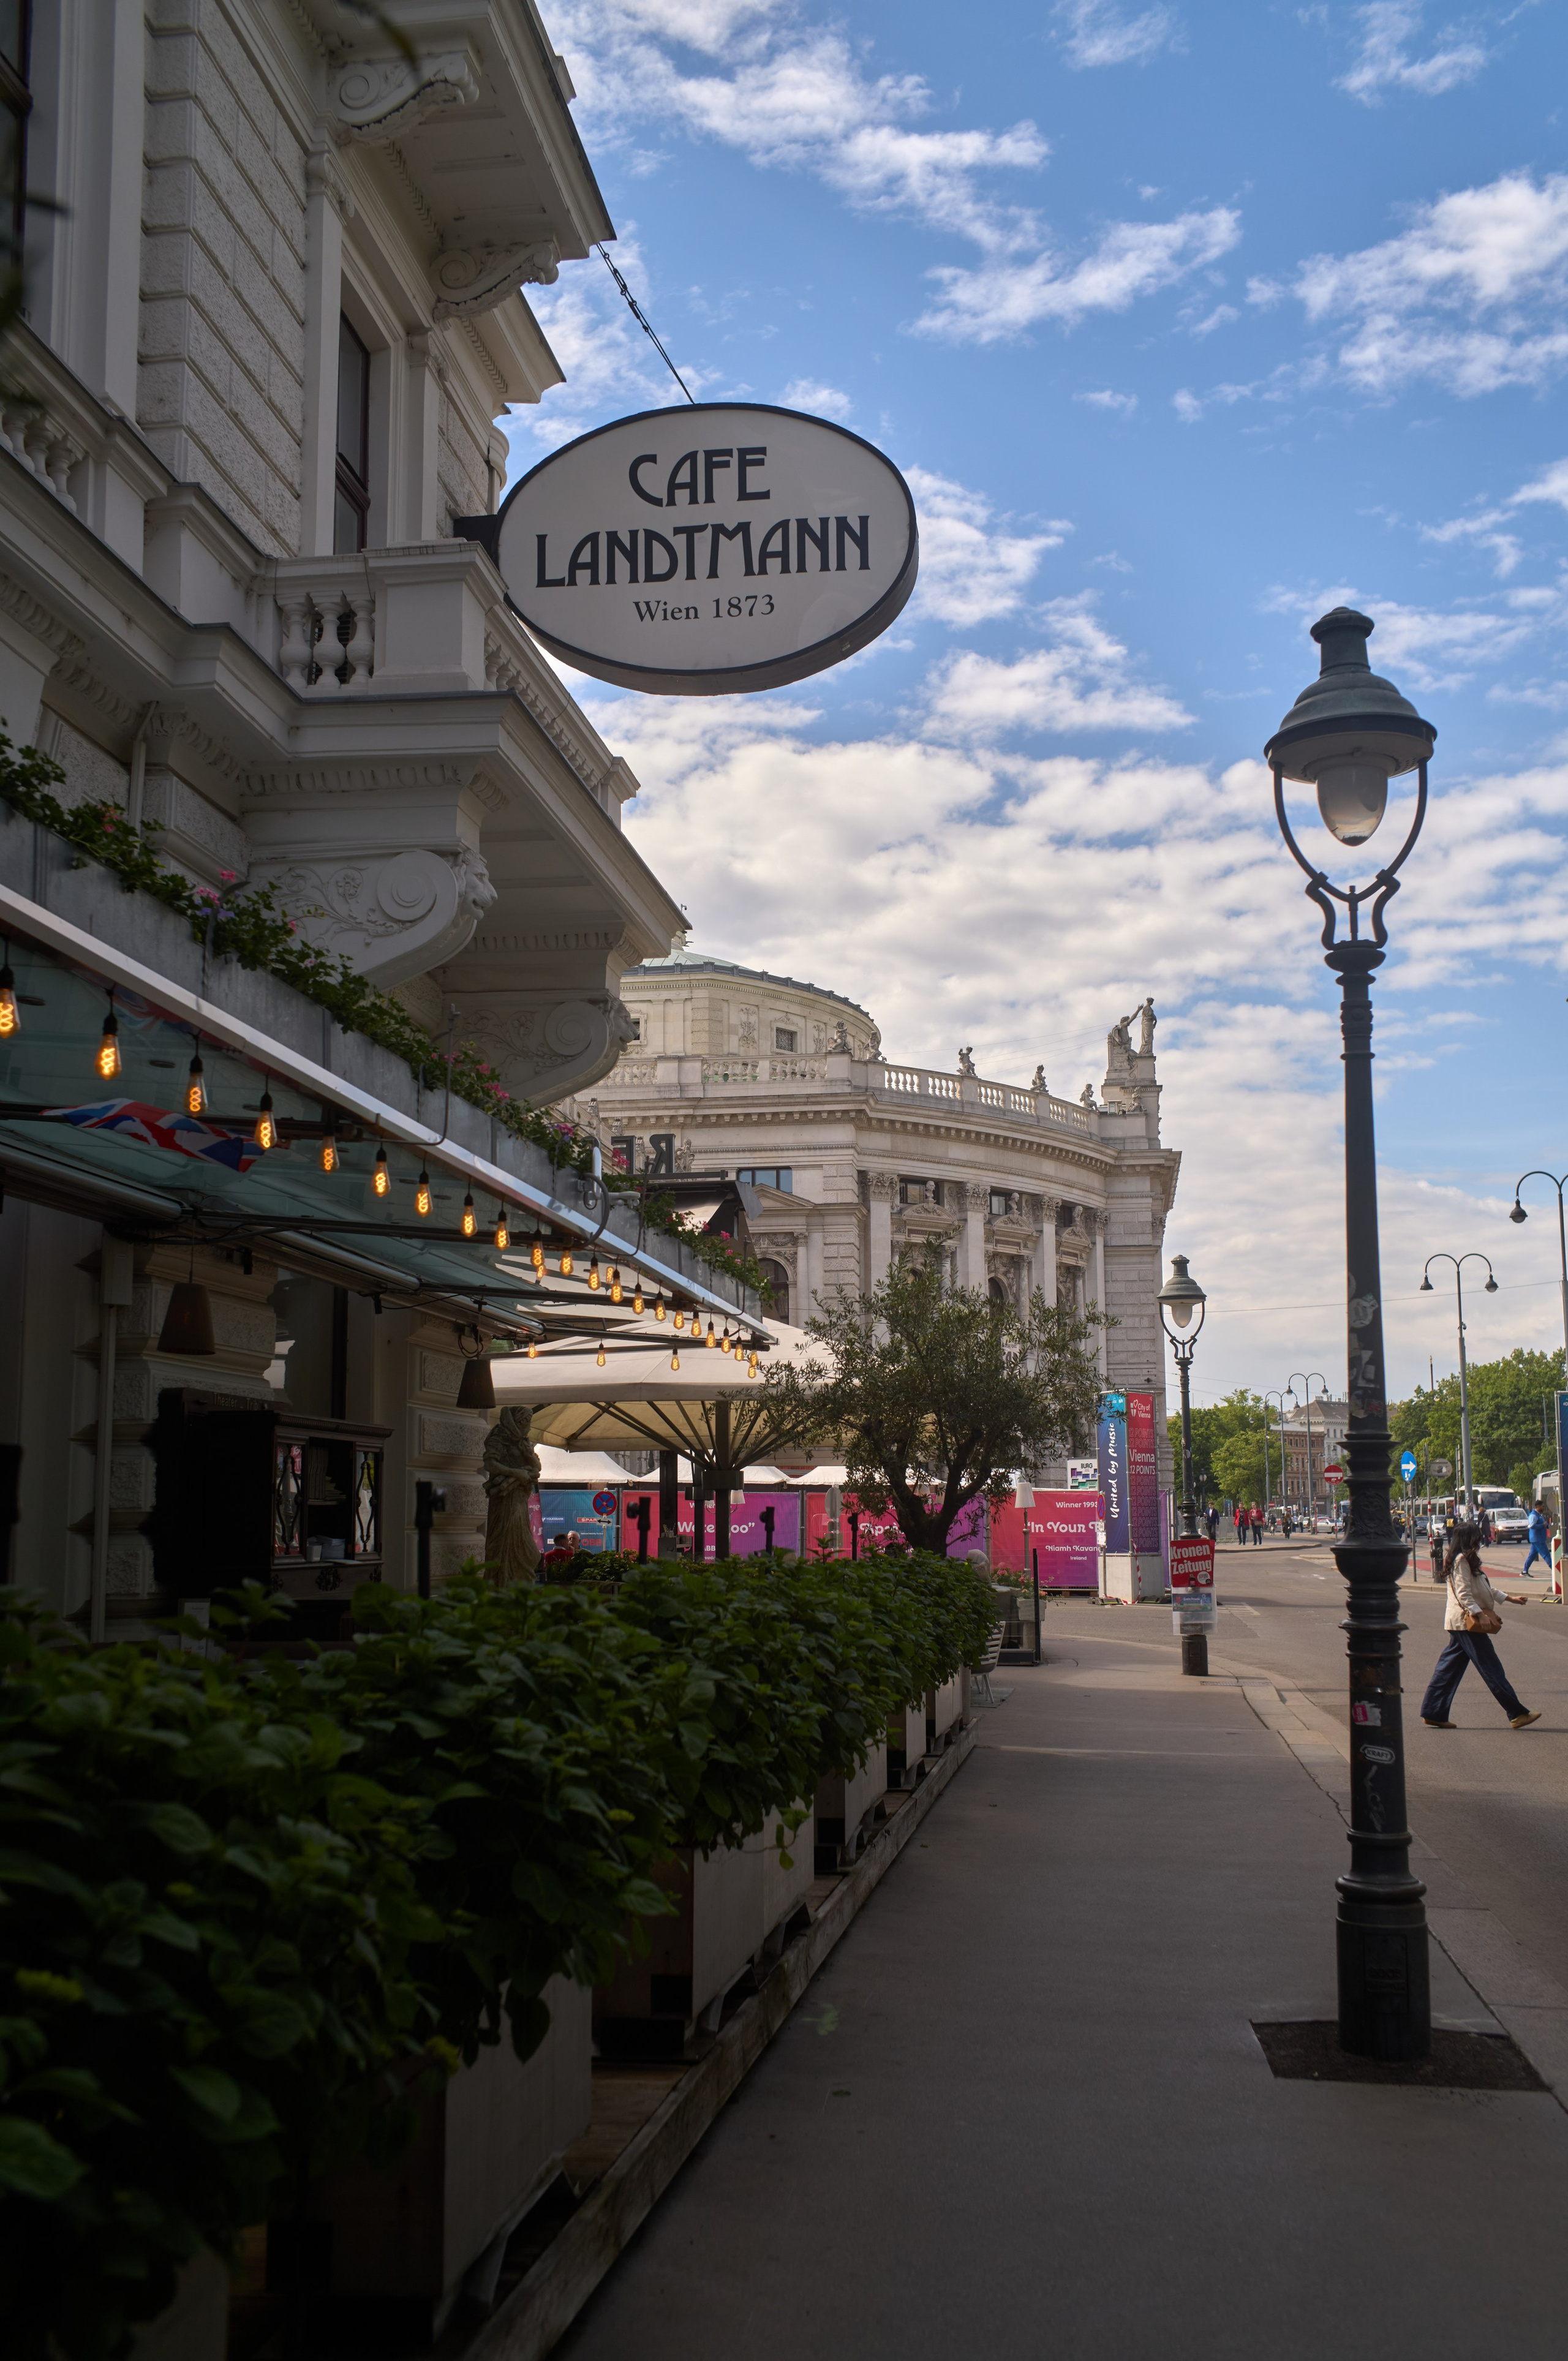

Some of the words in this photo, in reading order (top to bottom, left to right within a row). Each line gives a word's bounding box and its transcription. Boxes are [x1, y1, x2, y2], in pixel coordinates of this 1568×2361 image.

[628, 446, 771, 507] CAFE
[535, 515, 870, 588] LANDTMANN
[633, 600, 700, 622] Wien
[712, 594, 775, 619] 1873
[213, 1392, 238, 1408] Theater
[1108, 1423, 1118, 1457] Music
[1129, 1449, 1155, 1463] Vienna
[1108, 1461, 1118, 1474] by
[1129, 1465, 1135, 1474] 12
[1136, 1466, 1156, 1475] POINTS
[1108, 1478, 1120, 1518] United
[1047, 1521, 1086, 1533] Your
[1170, 1544, 1210, 1560] Kronen
[1171, 1559, 1212, 1575] Zeitung
[1366, 1749, 1389, 1758] KRAFT
